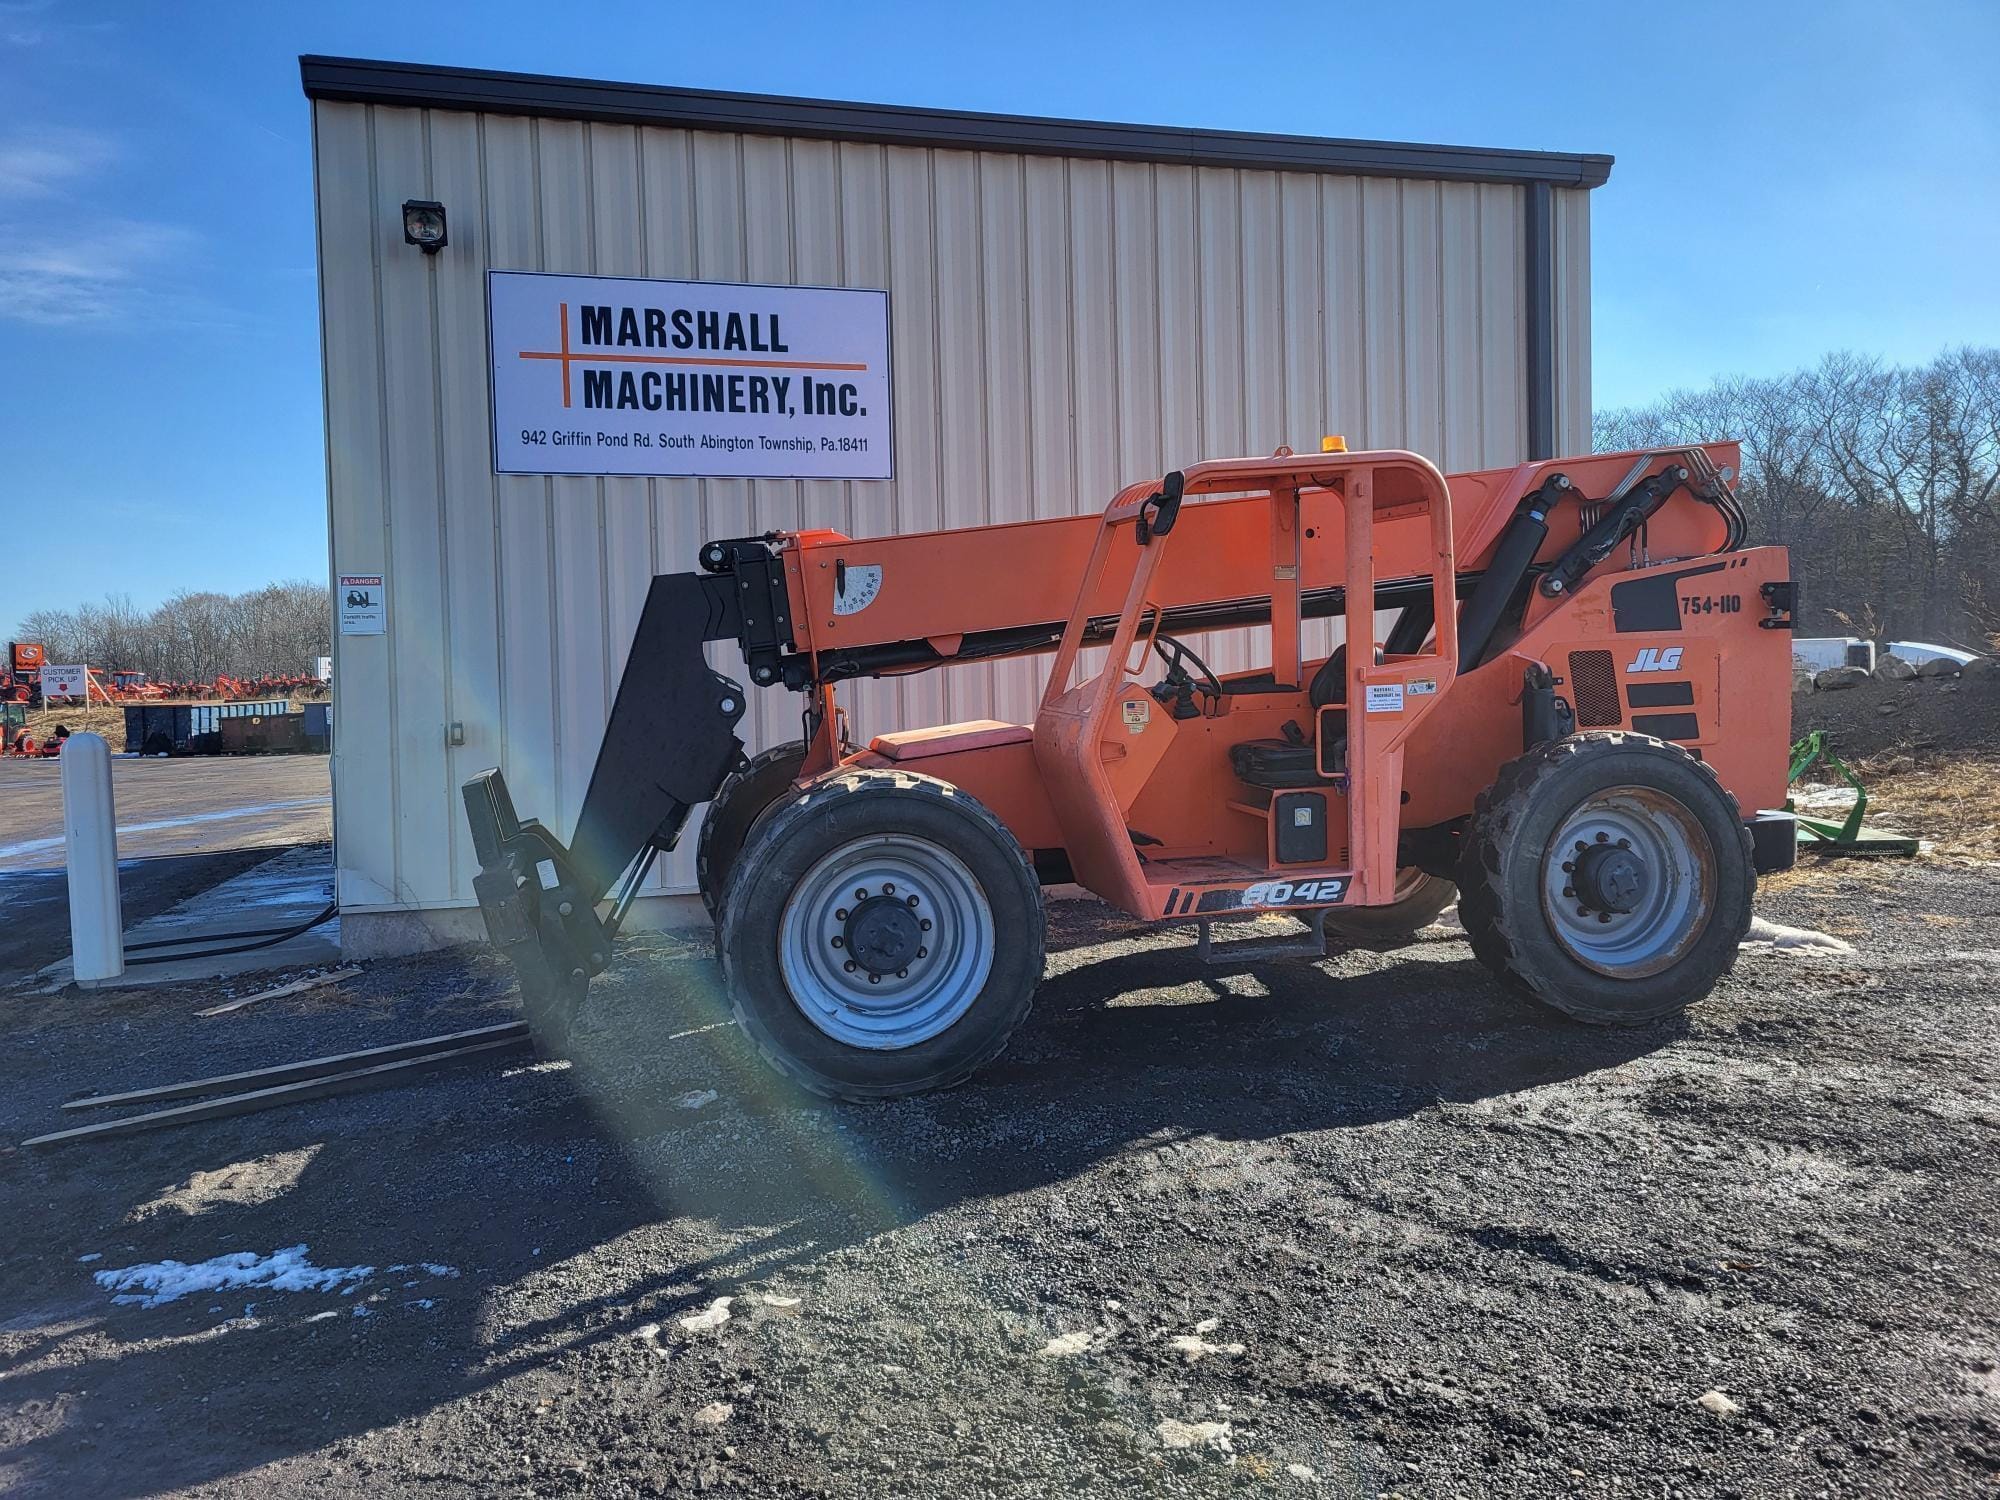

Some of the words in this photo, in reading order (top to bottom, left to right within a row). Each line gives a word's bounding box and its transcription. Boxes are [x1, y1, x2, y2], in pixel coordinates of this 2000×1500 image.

[581, 304, 789, 353] MARSHALL
[583, 369, 796, 419] MACHINERY,
[803, 376, 867, 416] Inc.
[521, 430, 547, 445] 942
[552, 431, 592, 446] Griffin
[597, 432, 628, 447] Pond
[634, 432, 653, 448] Rd.
[659, 433, 695, 448] South
[700, 434, 754, 452] Abington
[758, 435, 816, 454] Township,
[1681, 594, 1741, 615] 754-110
[1626, 647, 1684, 673] JLG
[67, 675, 78, 683] UP
[1241, 881, 1342, 905] 8042
